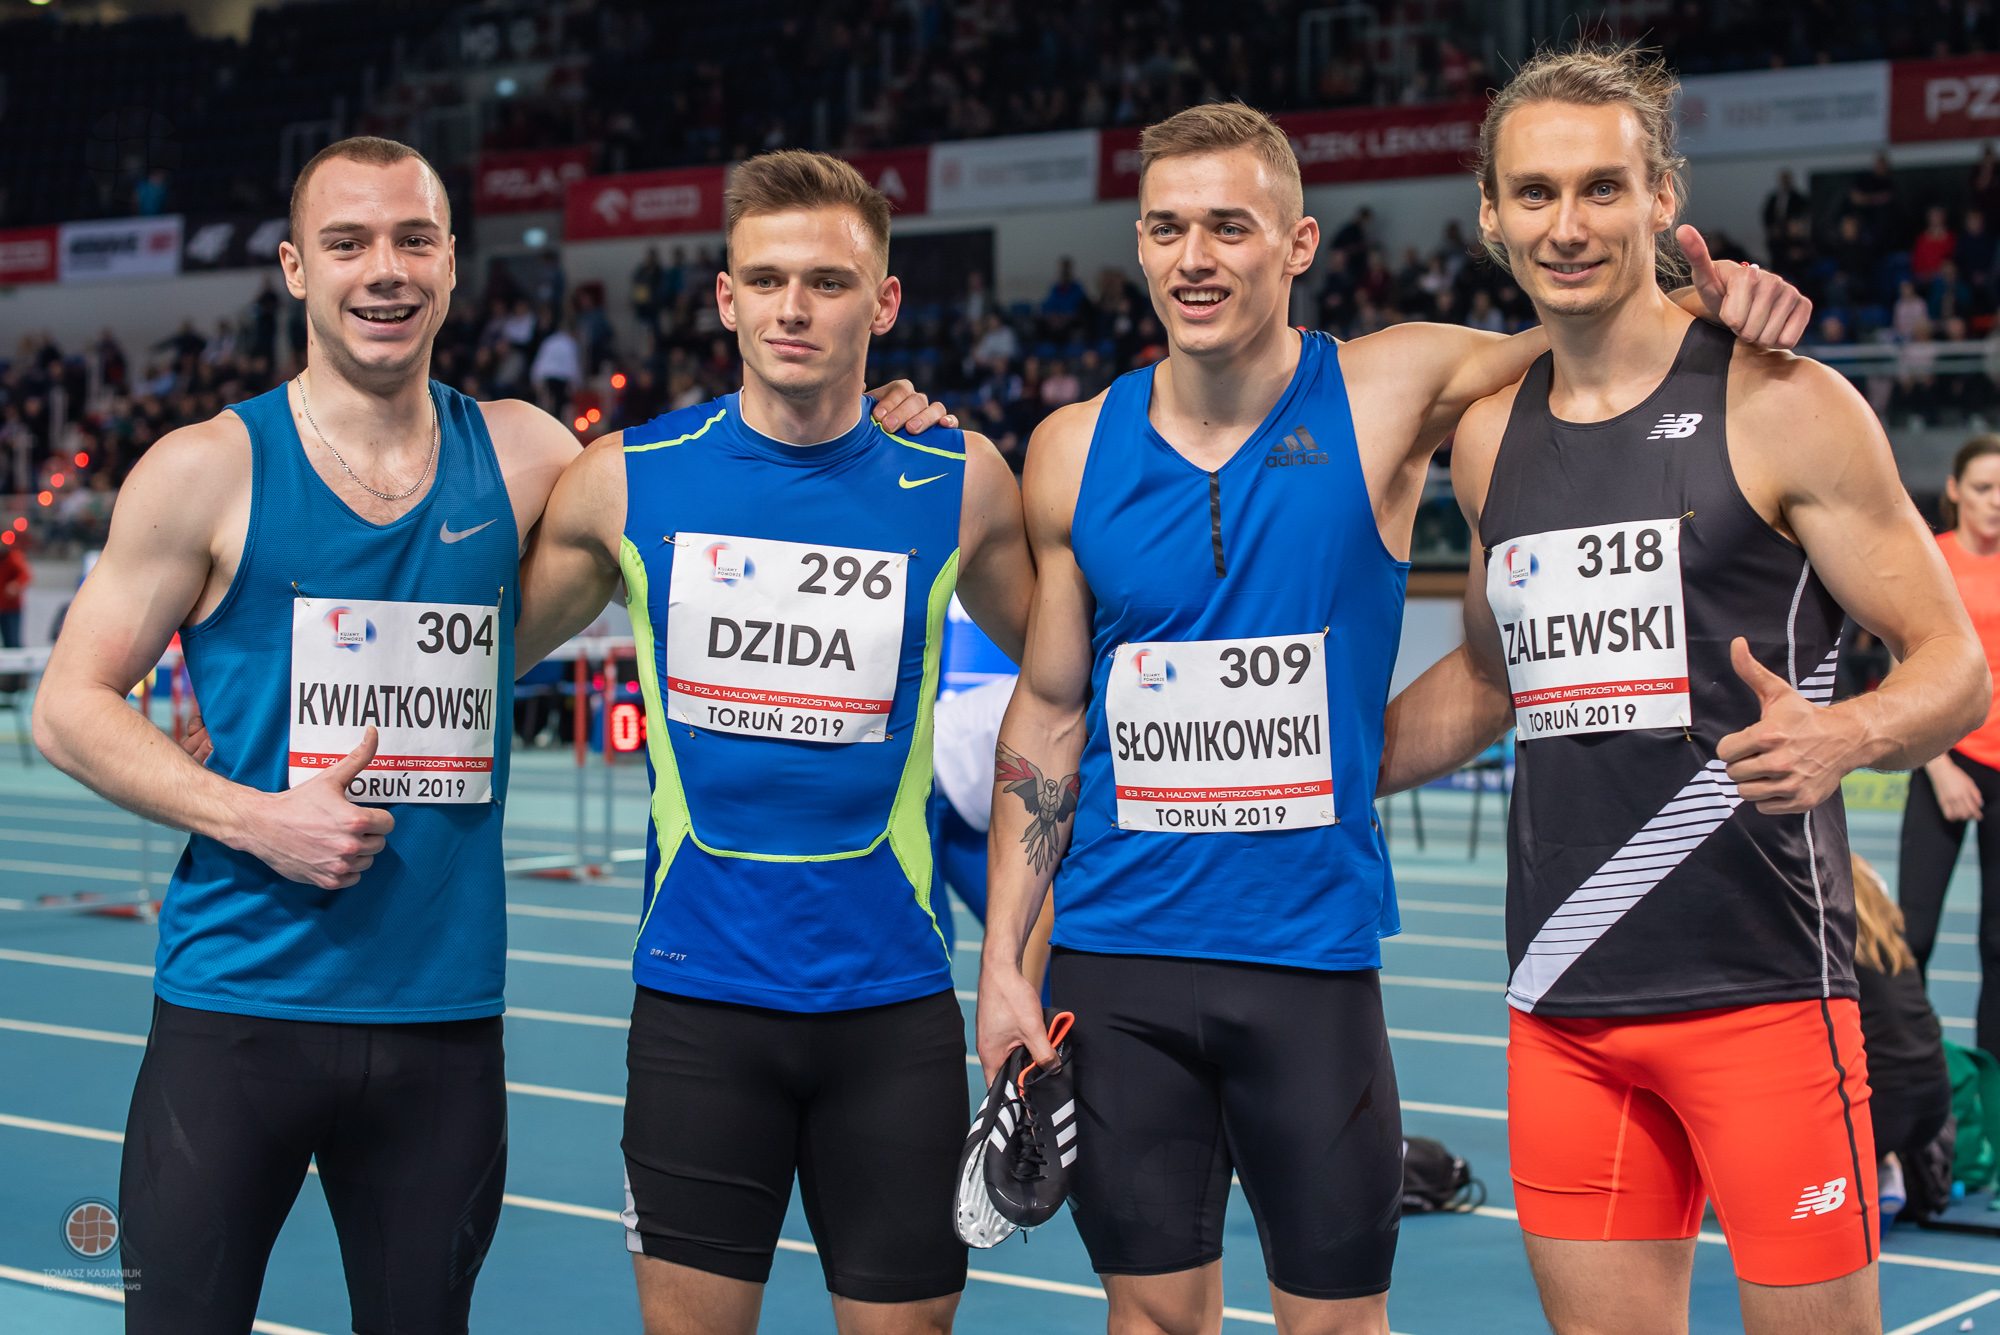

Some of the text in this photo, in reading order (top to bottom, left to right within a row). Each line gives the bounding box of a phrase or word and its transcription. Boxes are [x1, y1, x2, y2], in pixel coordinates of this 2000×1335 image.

[1266, 450, 1329, 468] adidas
[1578, 528, 1663, 578] 318
[798, 552, 892, 600] 296
[417, 612, 493, 656] 304
[708, 616, 855, 671] DZIDA
[1503, 605, 1674, 666] ZALEWSKI
[1220, 643, 1311, 688] 309
[298, 682, 492, 730] KWIATKOWSKI
[677, 682, 880, 710] 63. PZLA HALOWE MISTRZOSTWA POLSKI
[1532, 691, 1562, 701] HALOWE
[1563, 685, 1633, 698] MISTRZOSTWA
[1635, 682, 1674, 692] POLSKI
[708, 706, 844, 737] TORUŃ 2019
[1529, 702, 1636, 732] TORUŃ 2019
[1116, 714, 1321, 762] SŁOWIKOWSKI
[348, 772, 465, 798] ORUŃ 2019
[1125, 789, 1140, 797] 63.
[1166, 791, 1206, 799] HALOWE
[1209, 788, 1283, 798] MISTRZOSTWA
[1284, 785, 1320, 795] POLSKI
[1156, 803, 1286, 827] TORUŃ 2019
[650, 948, 687, 961] DRI-FIT
